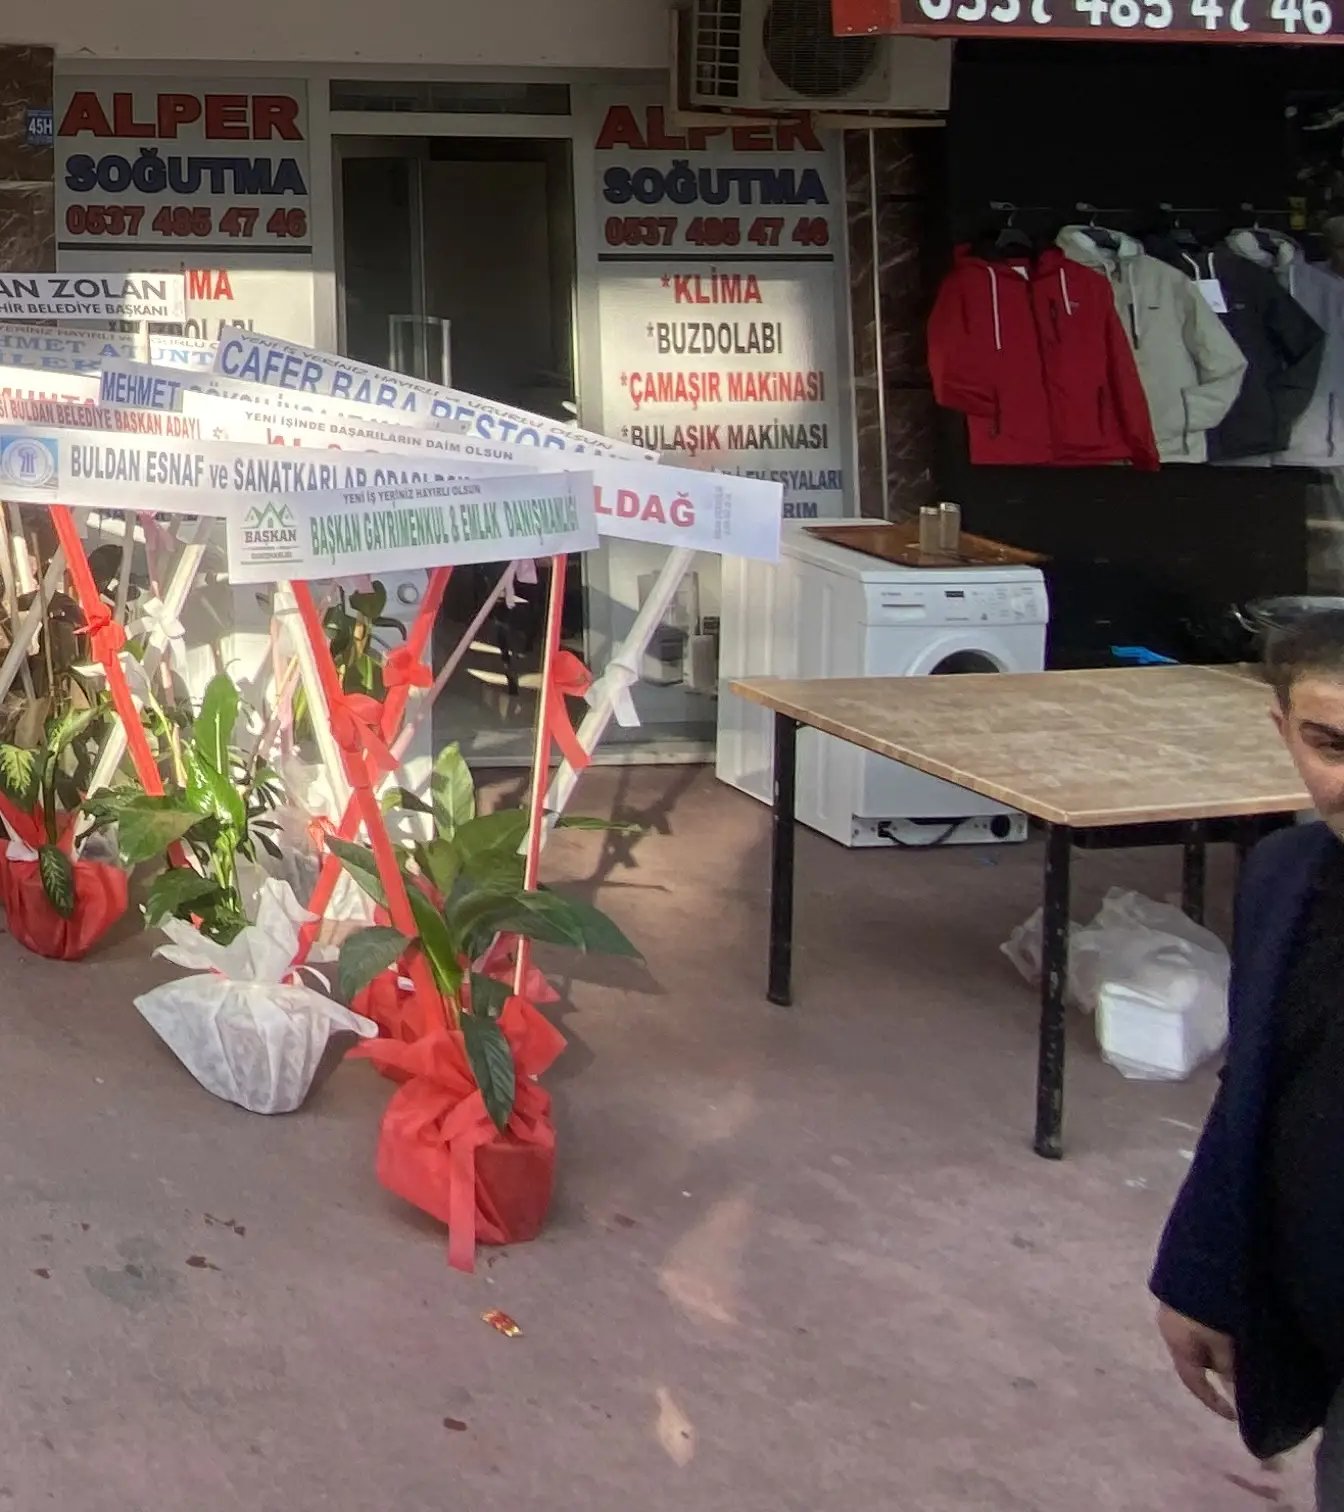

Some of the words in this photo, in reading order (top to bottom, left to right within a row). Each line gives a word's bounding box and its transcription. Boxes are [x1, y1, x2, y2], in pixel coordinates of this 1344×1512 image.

[57, 91, 305, 141] ALPER
[65, 147, 308, 196] SOĞUTMA
[603, 159, 830, 205] SOĞUTMA
[65, 204, 145, 237] 0537
[152, 205, 212, 237] 485
[219, 206, 260, 238] 47
[266, 207, 308, 238] 46
[48, 278, 167, 302] ZOLAN
[674, 266, 763, 304] KLİMA
[27, 299, 103, 316] BELEDİYE
[105, 302, 168, 319] BAŞKANI
[656, 322, 783, 354] BUZDOLABI
[220, 340, 323, 395] CAFER
[101, 371, 181, 411] MEHMET
[630, 371, 721, 411] ÇAMAŞIR
[166, 418, 201, 440] ADAYI
[727, 418, 828, 451] MAKİNASI
[71, 444, 141, 483] BULDAN
[146, 453, 205, 488] ESNAF
[465, 445, 514, 461] OLSUN
